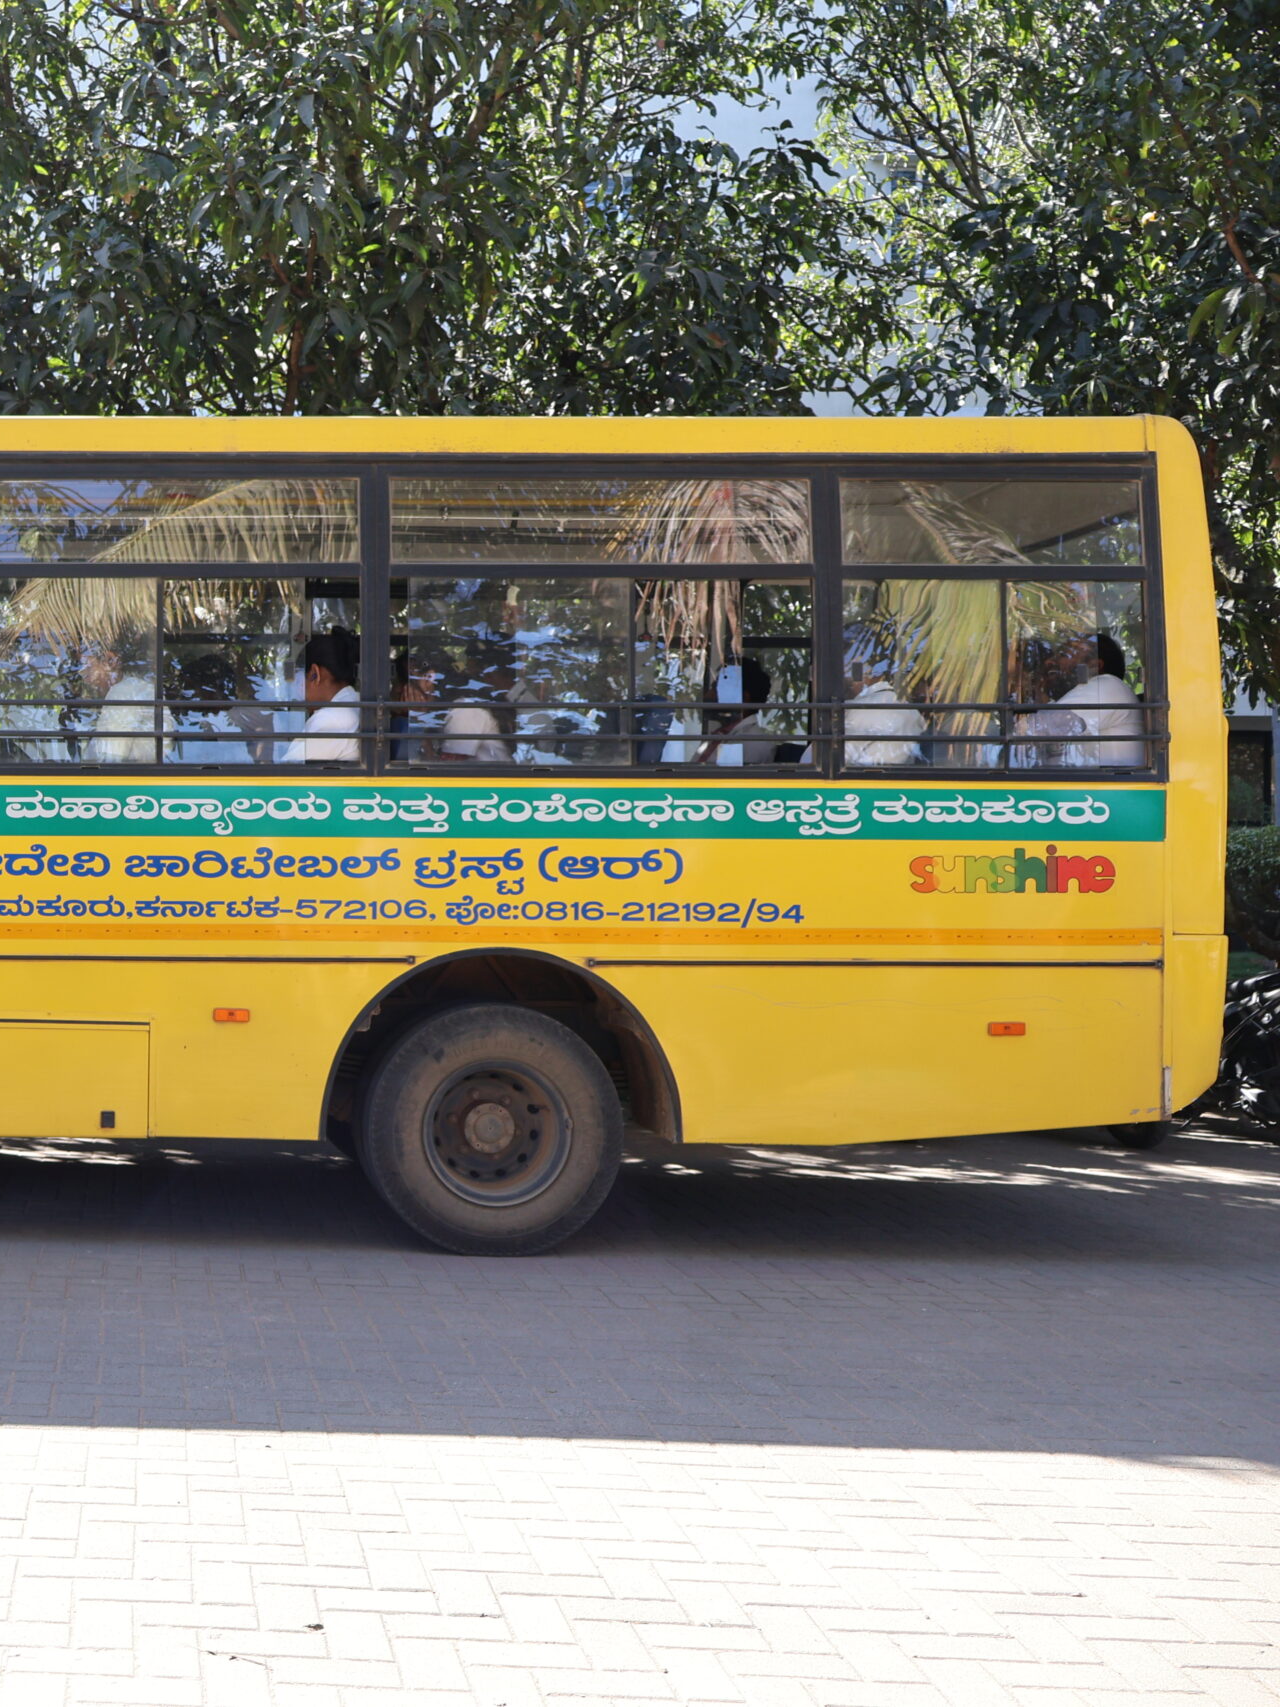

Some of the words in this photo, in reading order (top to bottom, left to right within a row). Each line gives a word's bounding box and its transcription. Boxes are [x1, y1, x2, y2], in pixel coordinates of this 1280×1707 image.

[6, 791, 332, 834] ಮಹಾವಿದ್ಯಾಲಯ
[344, 793, 450, 833] ಮತ್ತು
[461, 793, 735, 829] ಸಂಶೋಧನಾ
[746, 793, 862, 836] ಆಸ್ಪತ್ರೆ
[872, 795, 1110, 825] ತುಮಕೂರು
[124, 846, 401, 879] ಚಾರಿಟೇಬಲ್
[413, 847, 525, 895] ಟ್ರಸ್ಟ್
[538, 846, 684, 885] (ಆರ್)
[909, 844, 1116, 893] sunshine
